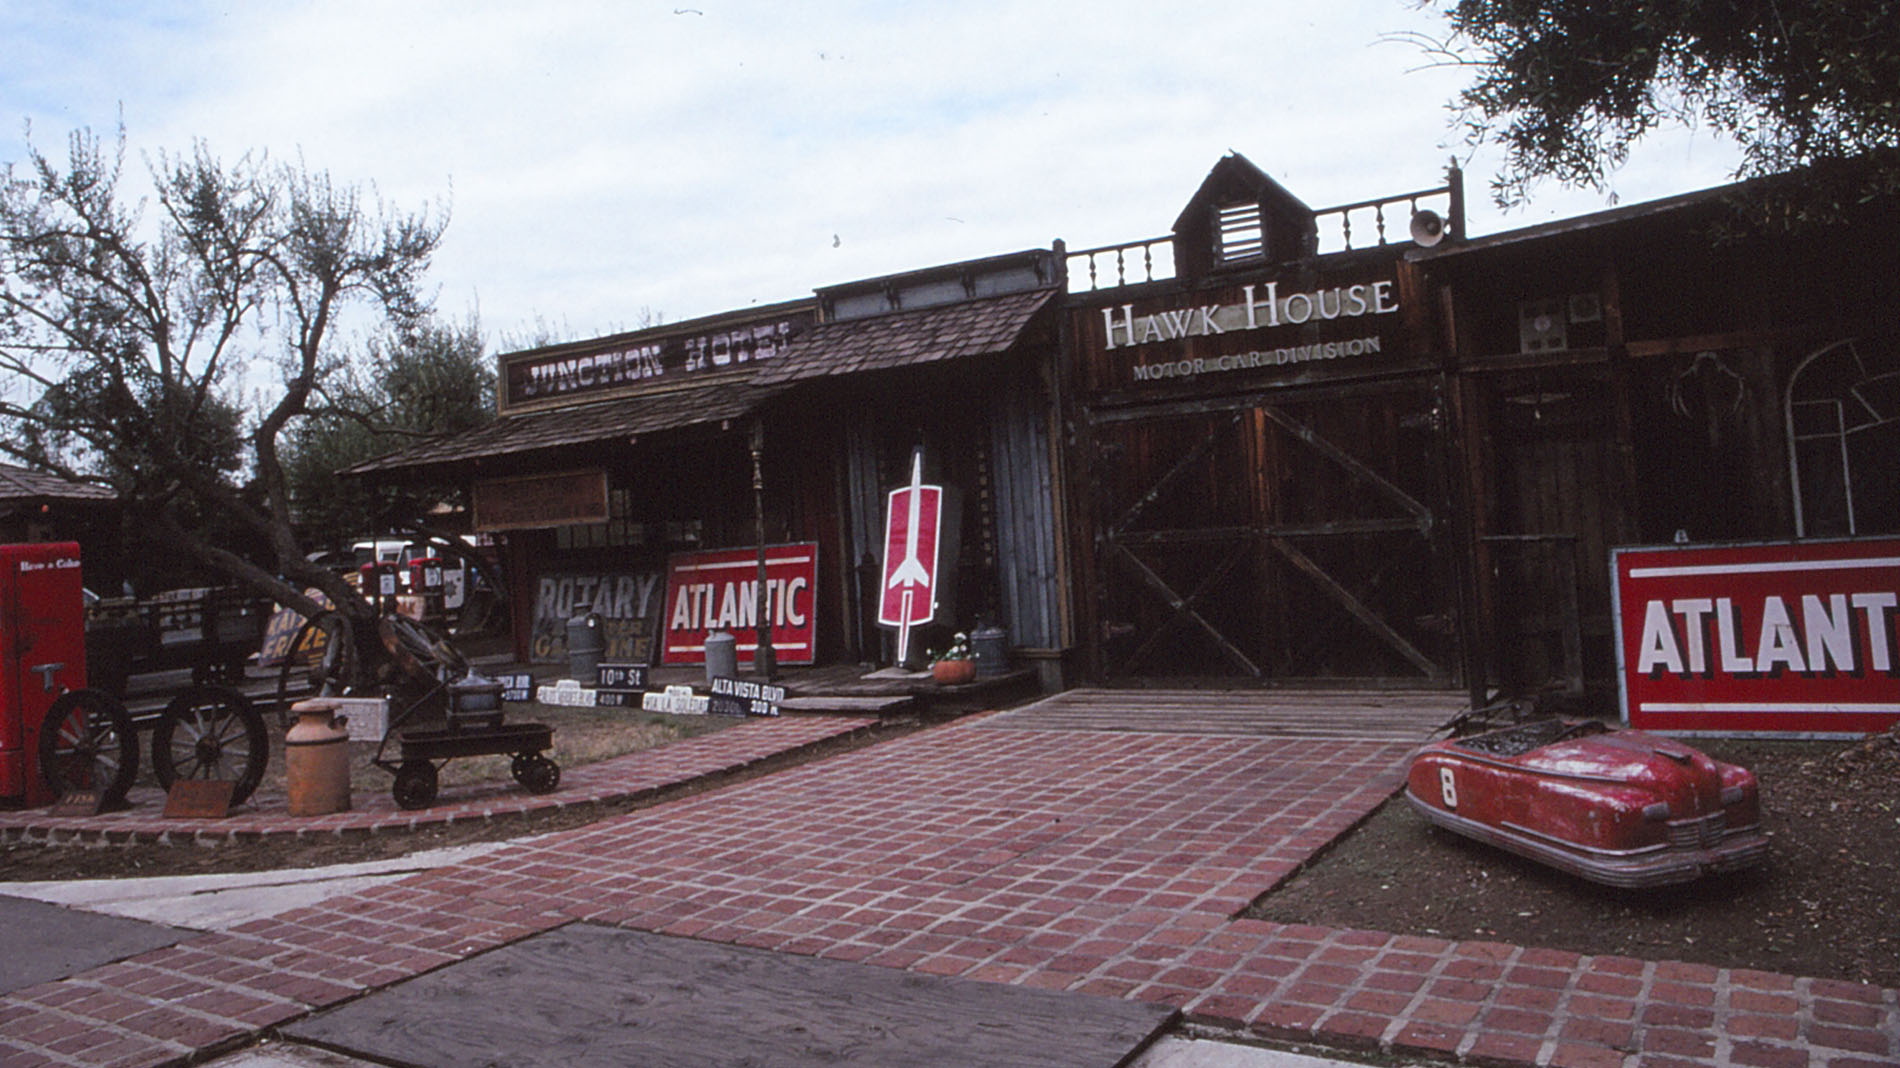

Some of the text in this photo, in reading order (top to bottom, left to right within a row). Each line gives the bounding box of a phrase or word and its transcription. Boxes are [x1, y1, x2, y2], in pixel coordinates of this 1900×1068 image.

[1101, 281, 1399, 350] HAWK HOUSE
[525, 345, 664, 395] JUNCTION
[1133, 336, 1382, 382] MOTOR CAR DIVISION
[537, 575, 660, 619] ROTARY
[671, 577, 806, 629] ATLANTIC
[1638, 592, 1898, 673] ATLANT
[601, 669, 641, 686] 10th St
[711, 677, 785, 703] ALTA VISTA BLVD
[750, 700, 768, 714] 300
[1440, 767, 1458, 808] 8
